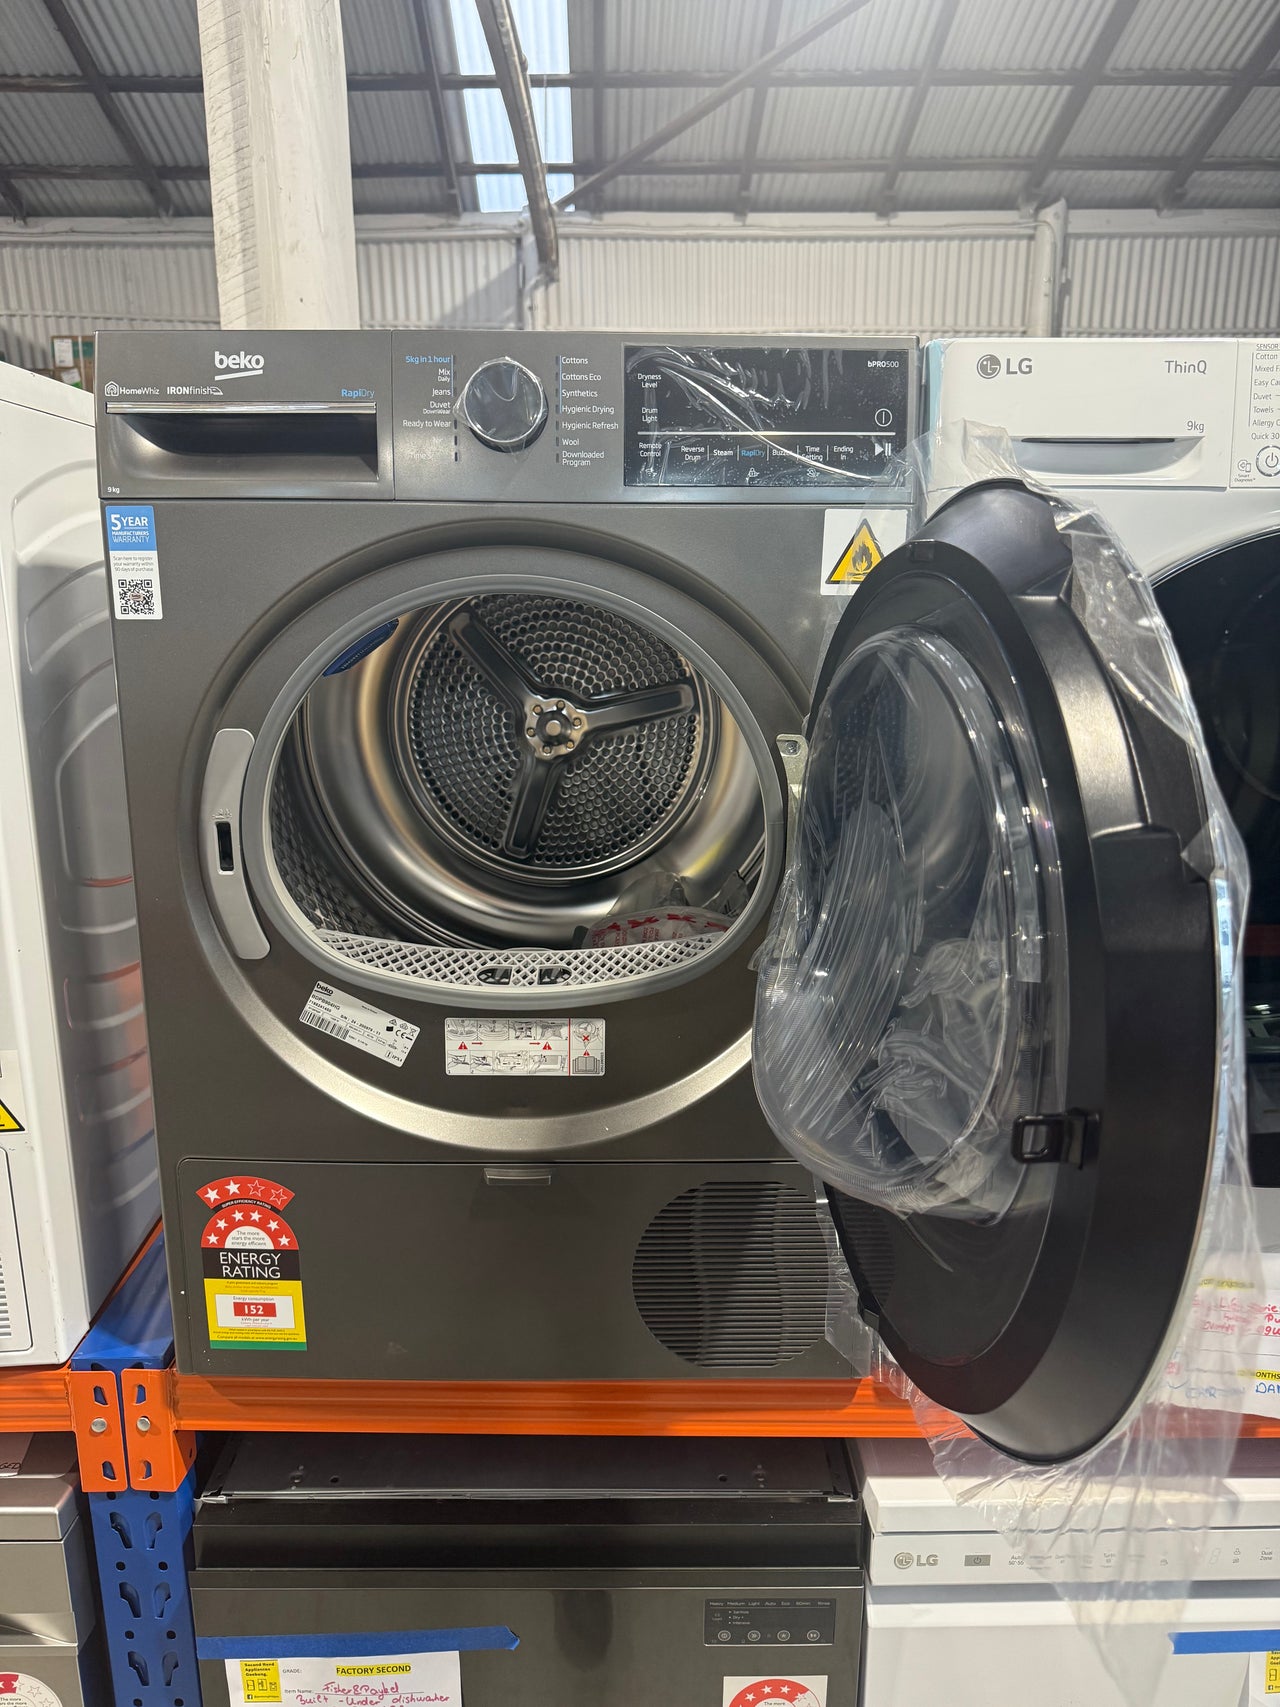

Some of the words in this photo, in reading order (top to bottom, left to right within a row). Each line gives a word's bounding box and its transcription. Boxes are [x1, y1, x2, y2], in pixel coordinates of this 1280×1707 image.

[214, 350, 265, 370] beko
[405, 356, 420, 364] 5kg
[562, 356, 588, 364] Cottons
[868, 360, 899, 368] bPRO500
[1006, 358, 1033, 375] LG
[1164, 360, 1208, 376] ThinQ
[438, 368, 450, 376] Mix
[638, 374, 662, 382] Dryness
[1254, 379, 1269, 387] Easy
[120, 386, 160, 396] HomeWhiz
[166, 386, 211, 396] IRONfinish
[340, 388, 375, 399] RapiDry
[432, 388, 451, 397] Jeans
[562, 390, 598, 398] Synthetics
[562, 406, 588, 414] Hygienic
[590, 406, 615, 414] Drying
[1254, 406, 1274, 414] Towels
[642, 415, 658, 423] Light
[402, 420, 424, 428] Ready
[562, 422, 592, 430] Hygienic
[593, 422, 619, 430] Refresh
[1186, 420, 1205, 433] 9kg
[1252, 419, 1275, 428] Allergy
[1251, 432, 1269, 440] Quick
[562, 438, 580, 446] Wool
[638, 442, 662, 450] Remote
[833, 446, 854, 454] Ending
[562, 451, 604, 459] Downloaded
[684, 453, 701, 461] Drum
[562, 459, 591, 467] Program
[113, 486, 120, 494] kg
[111, 514, 122, 530] 5
[121, 516, 148, 526] YEAR
[316, 982, 334, 995] beko
[219, 1252, 281, 1266] ENERGY
[222, 1266, 281, 1279] RATING
[244, 1305, 264, 1314] 152
[916, 1554, 938, 1566] LG
[336, 1666, 374, 1675] FACTORY
[376, 1665, 411, 1674] SECOND
